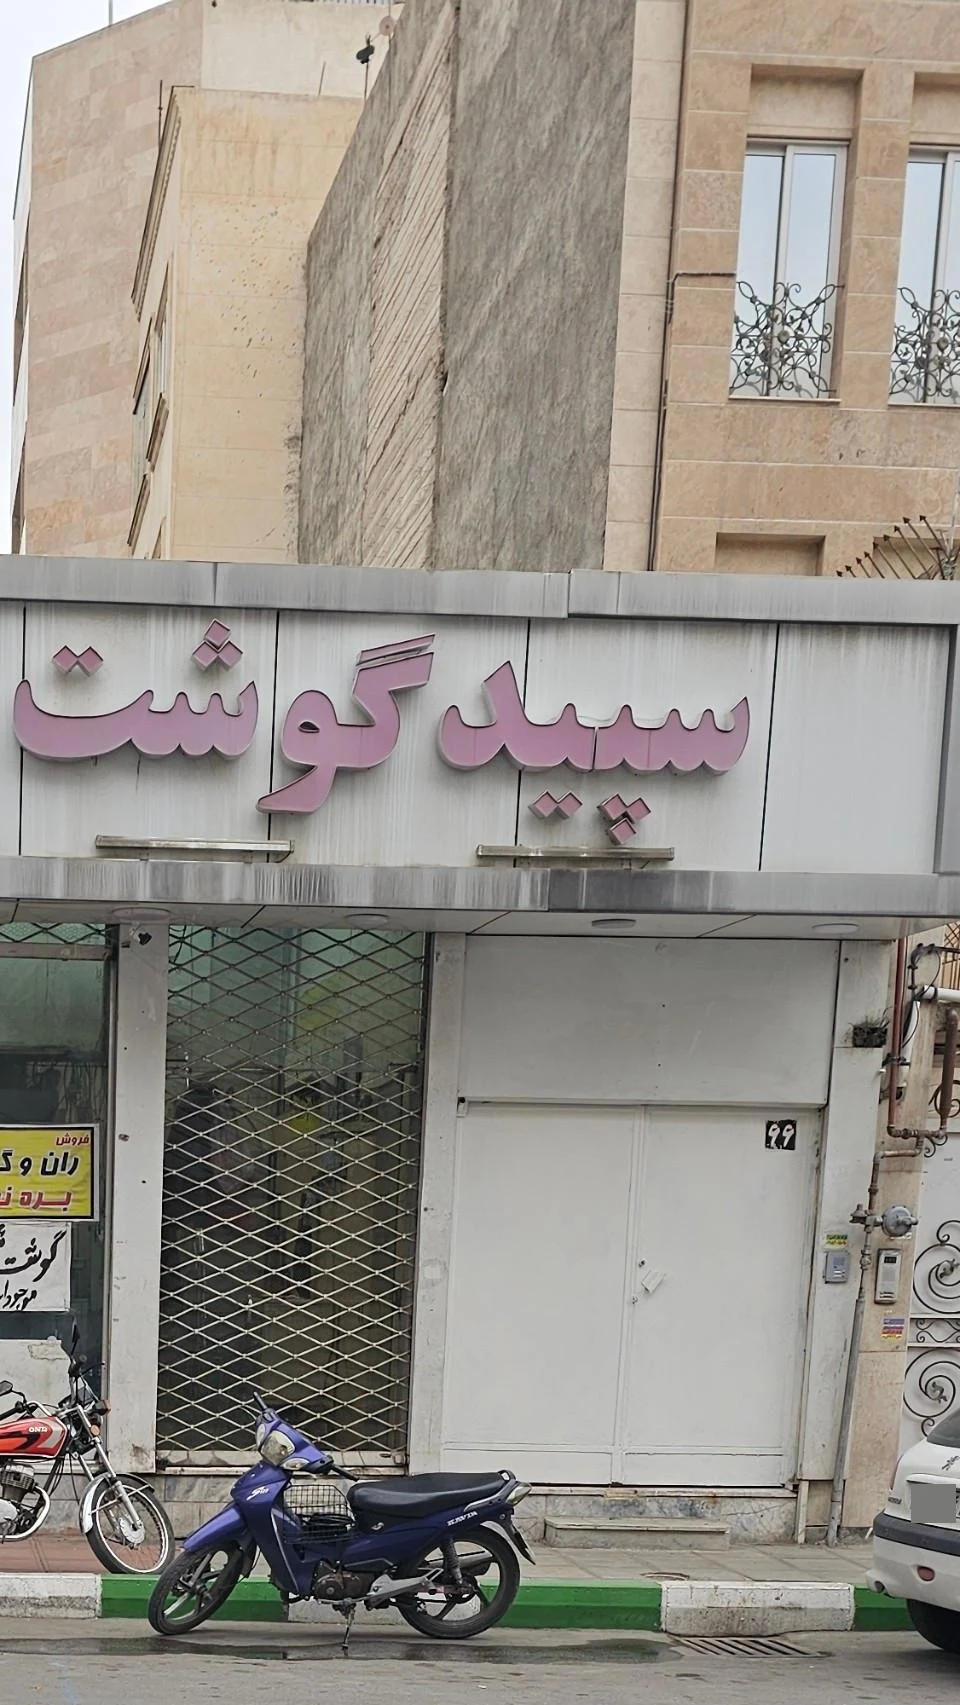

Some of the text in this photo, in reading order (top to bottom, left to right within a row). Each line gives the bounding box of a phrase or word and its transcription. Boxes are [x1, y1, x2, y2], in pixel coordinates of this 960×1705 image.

[13, 618, 436, 814] گوشت
[439, 660, 750, 844] سپید
[56, 1132, 90, 1146] فروش
[20, 1156, 33, 1177] و
[41, 1152, 79, 1176] ران
[19, 1191, 72, 1212] بره
